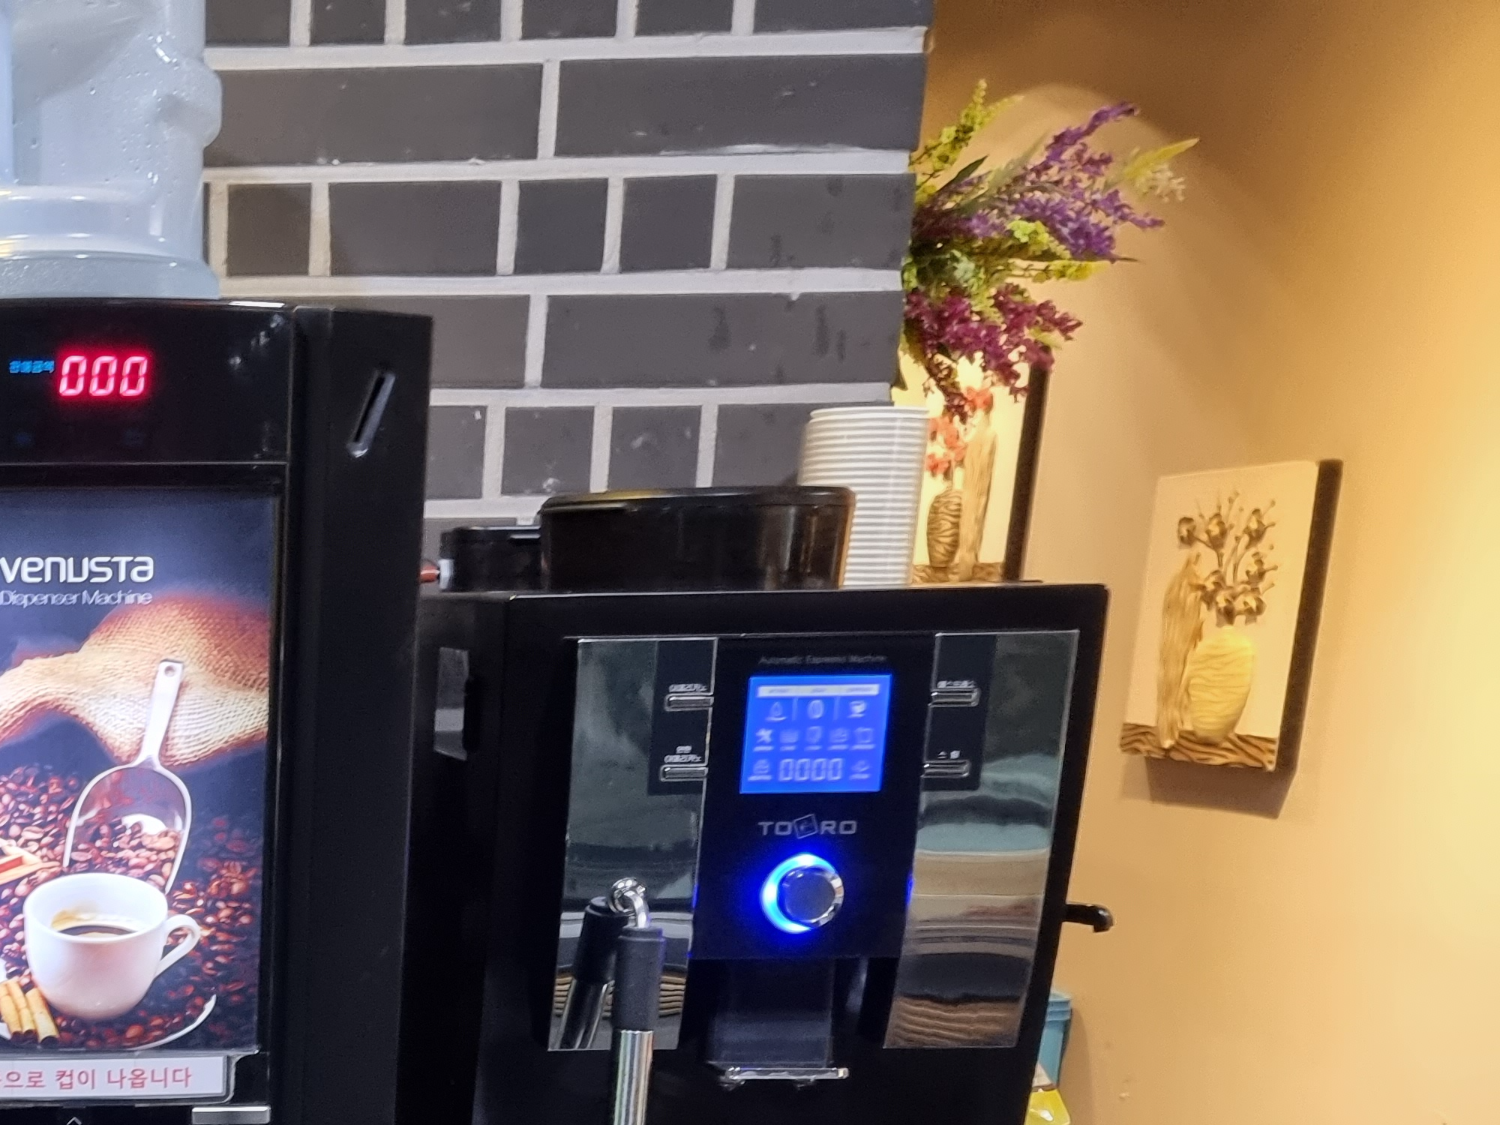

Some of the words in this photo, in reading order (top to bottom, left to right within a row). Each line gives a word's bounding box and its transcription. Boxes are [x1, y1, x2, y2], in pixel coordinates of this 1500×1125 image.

[59, 355, 148, 397] 000
[0, 590, 80, 608] Dispenser
[82, 589, 153, 606] Machine
[55, 1068, 97, 1091] 컵이
[106, 1066, 193, 1090] 나옵니다
